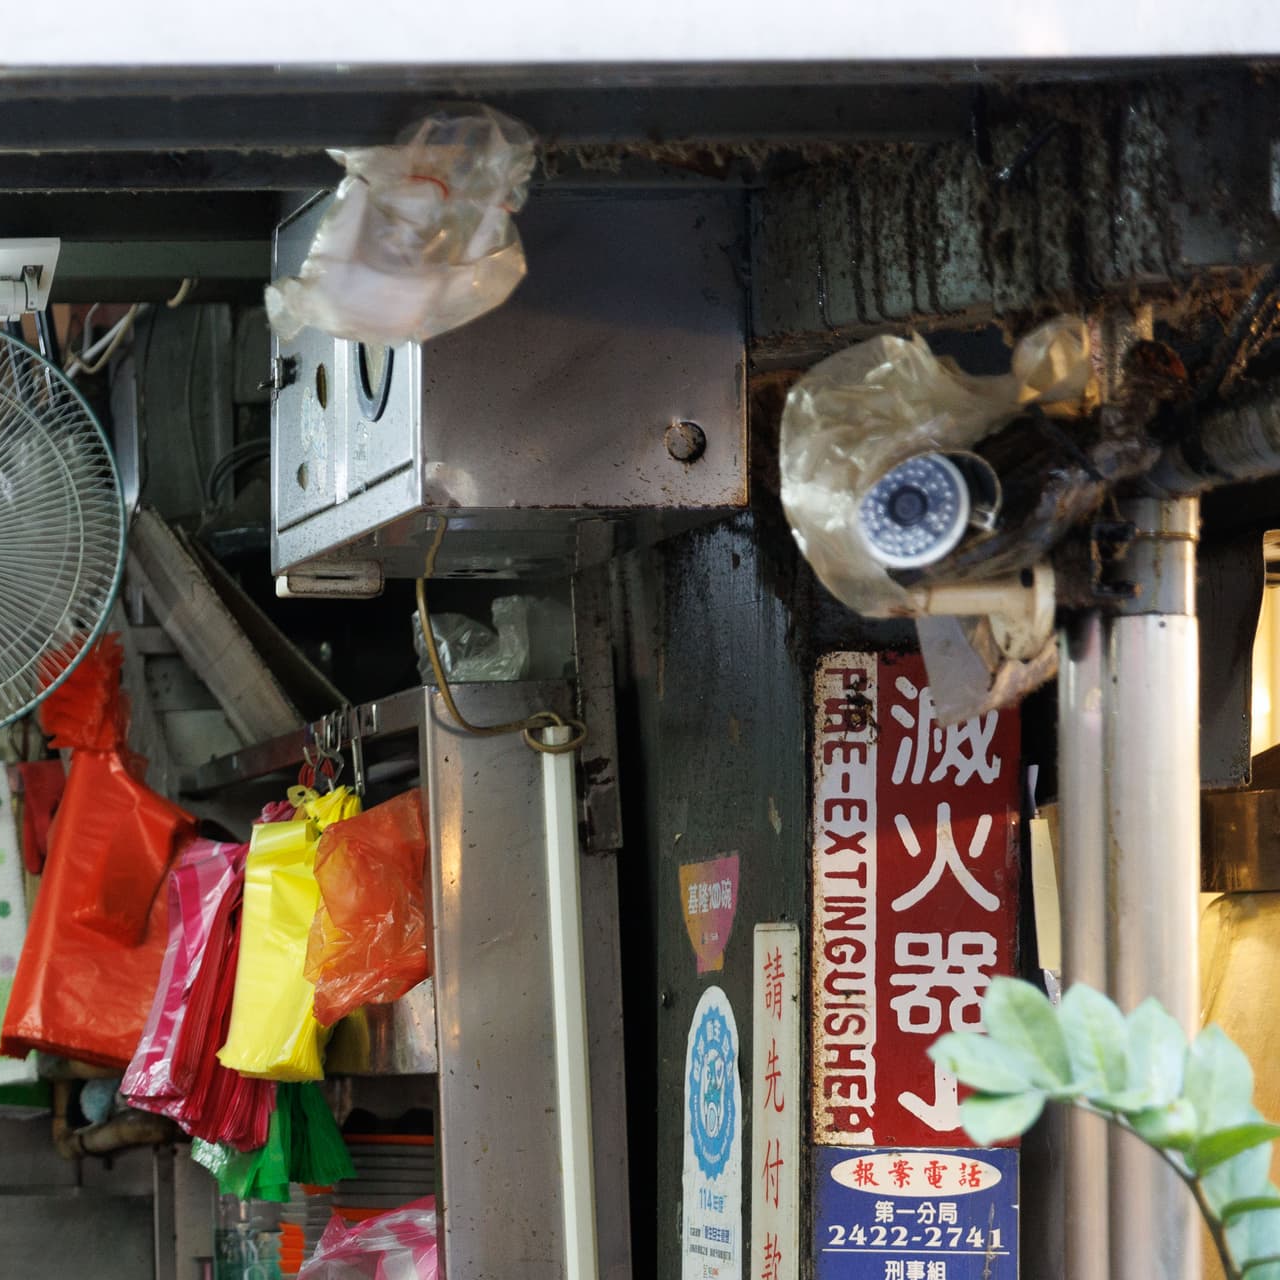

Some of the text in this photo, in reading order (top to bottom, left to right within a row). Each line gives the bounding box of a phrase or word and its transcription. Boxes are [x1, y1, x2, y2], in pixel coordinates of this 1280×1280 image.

[852, 1158, 984, 1190] 報案電話
[874, 1200, 958, 1225] 第一分局
[828, 1225, 1005, 1249] 2422-2741
